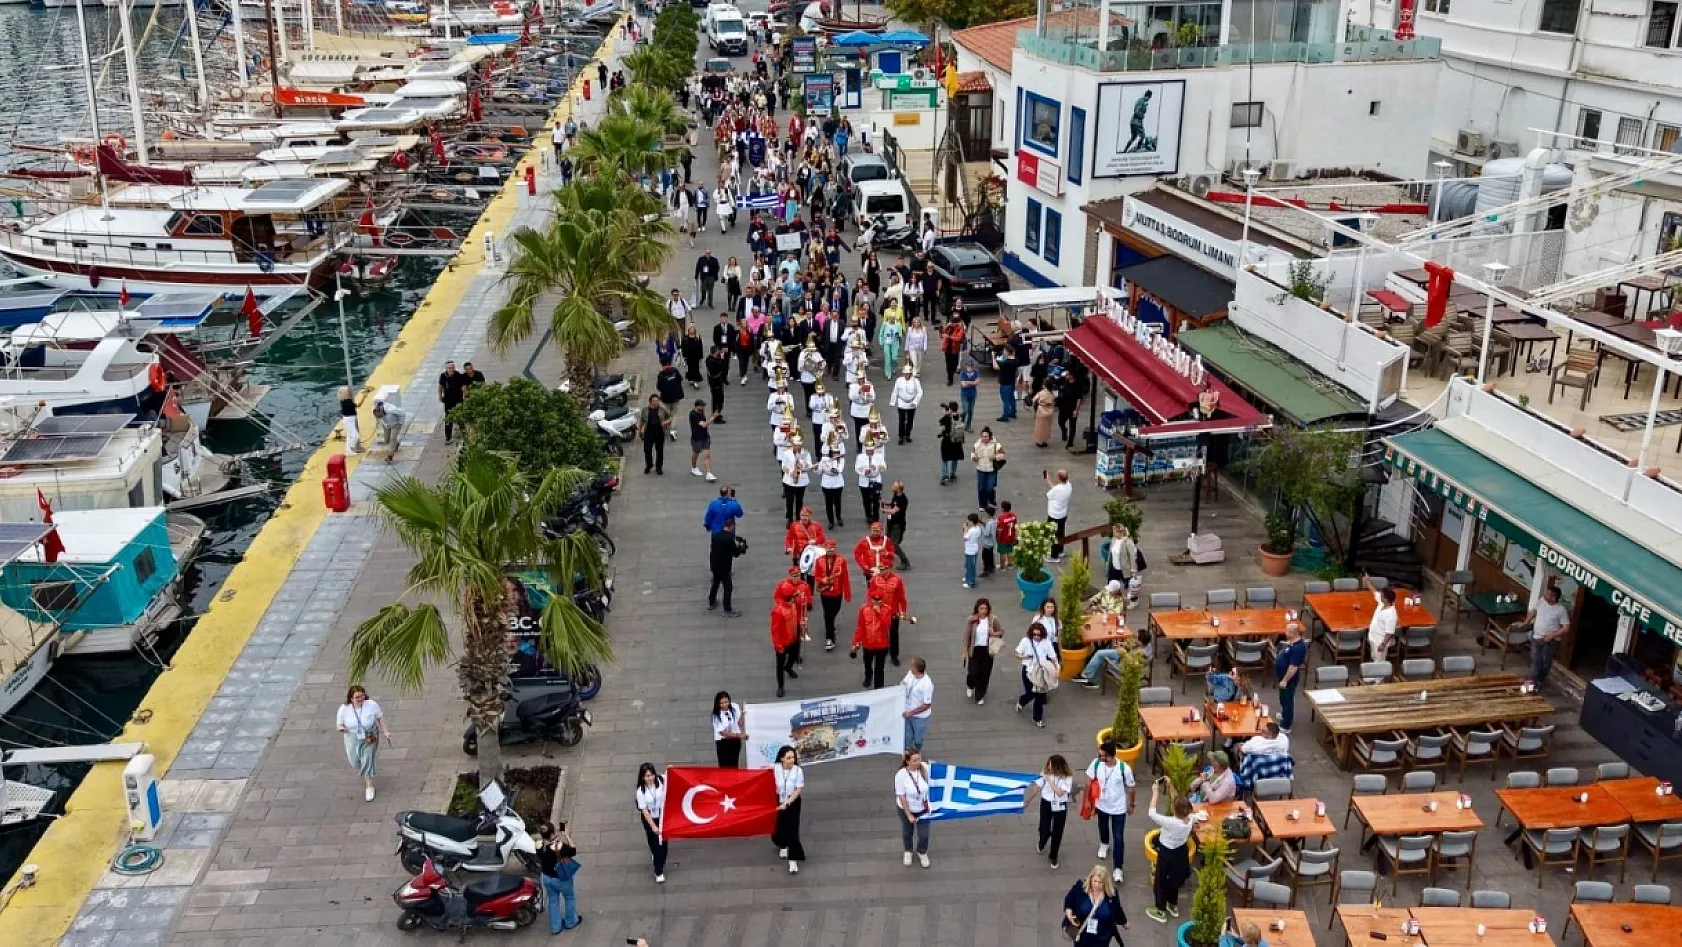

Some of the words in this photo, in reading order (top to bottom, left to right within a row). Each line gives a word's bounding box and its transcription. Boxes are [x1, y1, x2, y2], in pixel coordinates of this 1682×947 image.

[1166, 226, 1202, 253] BODRUM
[1007, 522, 1014, 536] 7
[1539, 543, 1599, 590] BODRUM
[1611, 589, 1651, 624] CAFE
